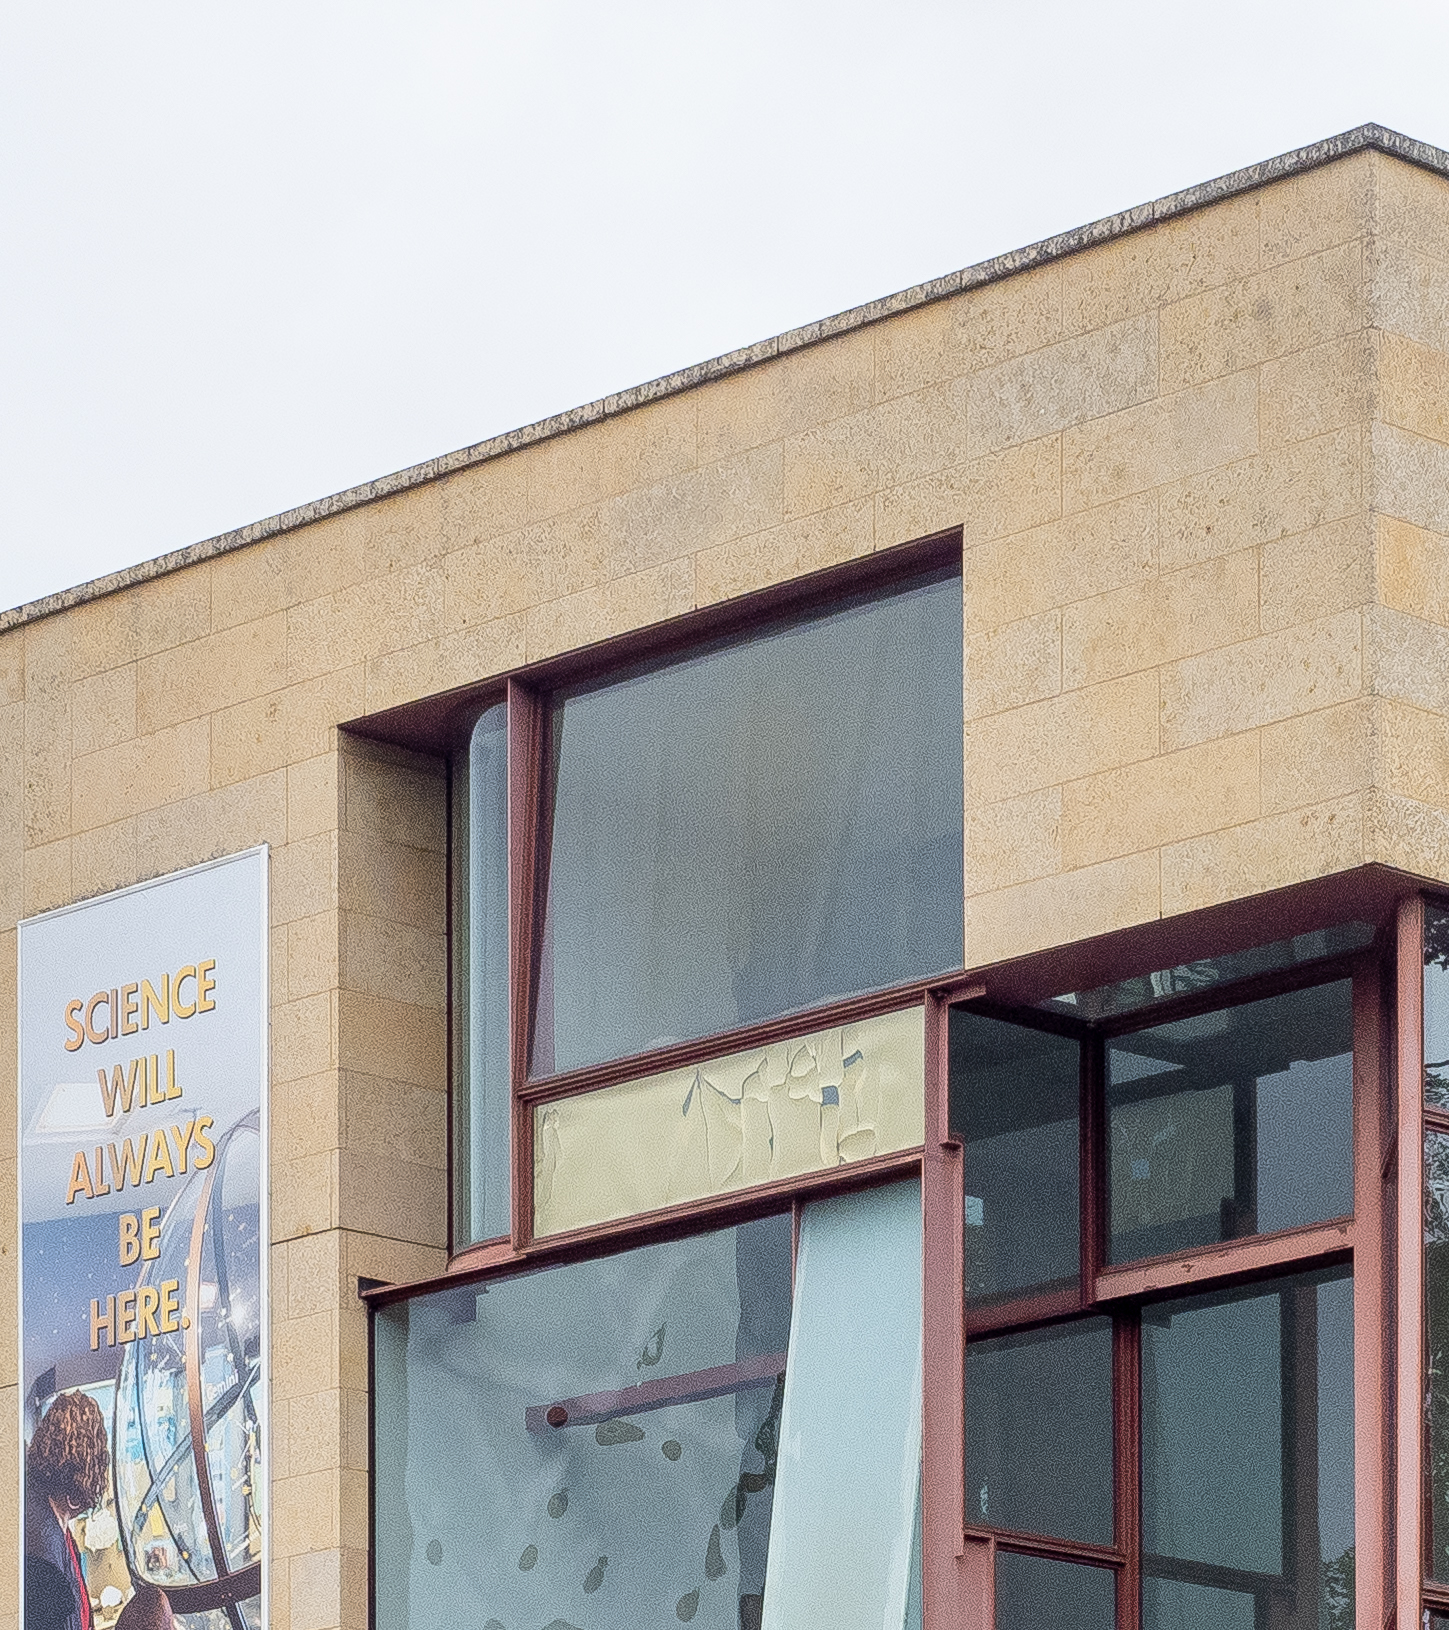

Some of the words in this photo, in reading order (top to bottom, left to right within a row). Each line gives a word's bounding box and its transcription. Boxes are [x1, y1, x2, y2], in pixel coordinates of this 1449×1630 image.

[64, 958, 216, 1052] SCIENCE
[97, 1048, 183, 1118] WILL
[66, 1115, 216, 1206] ALWAYS
[118, 1206, 161, 1267] BE
[89, 1278, 192, 1351] HERE.
